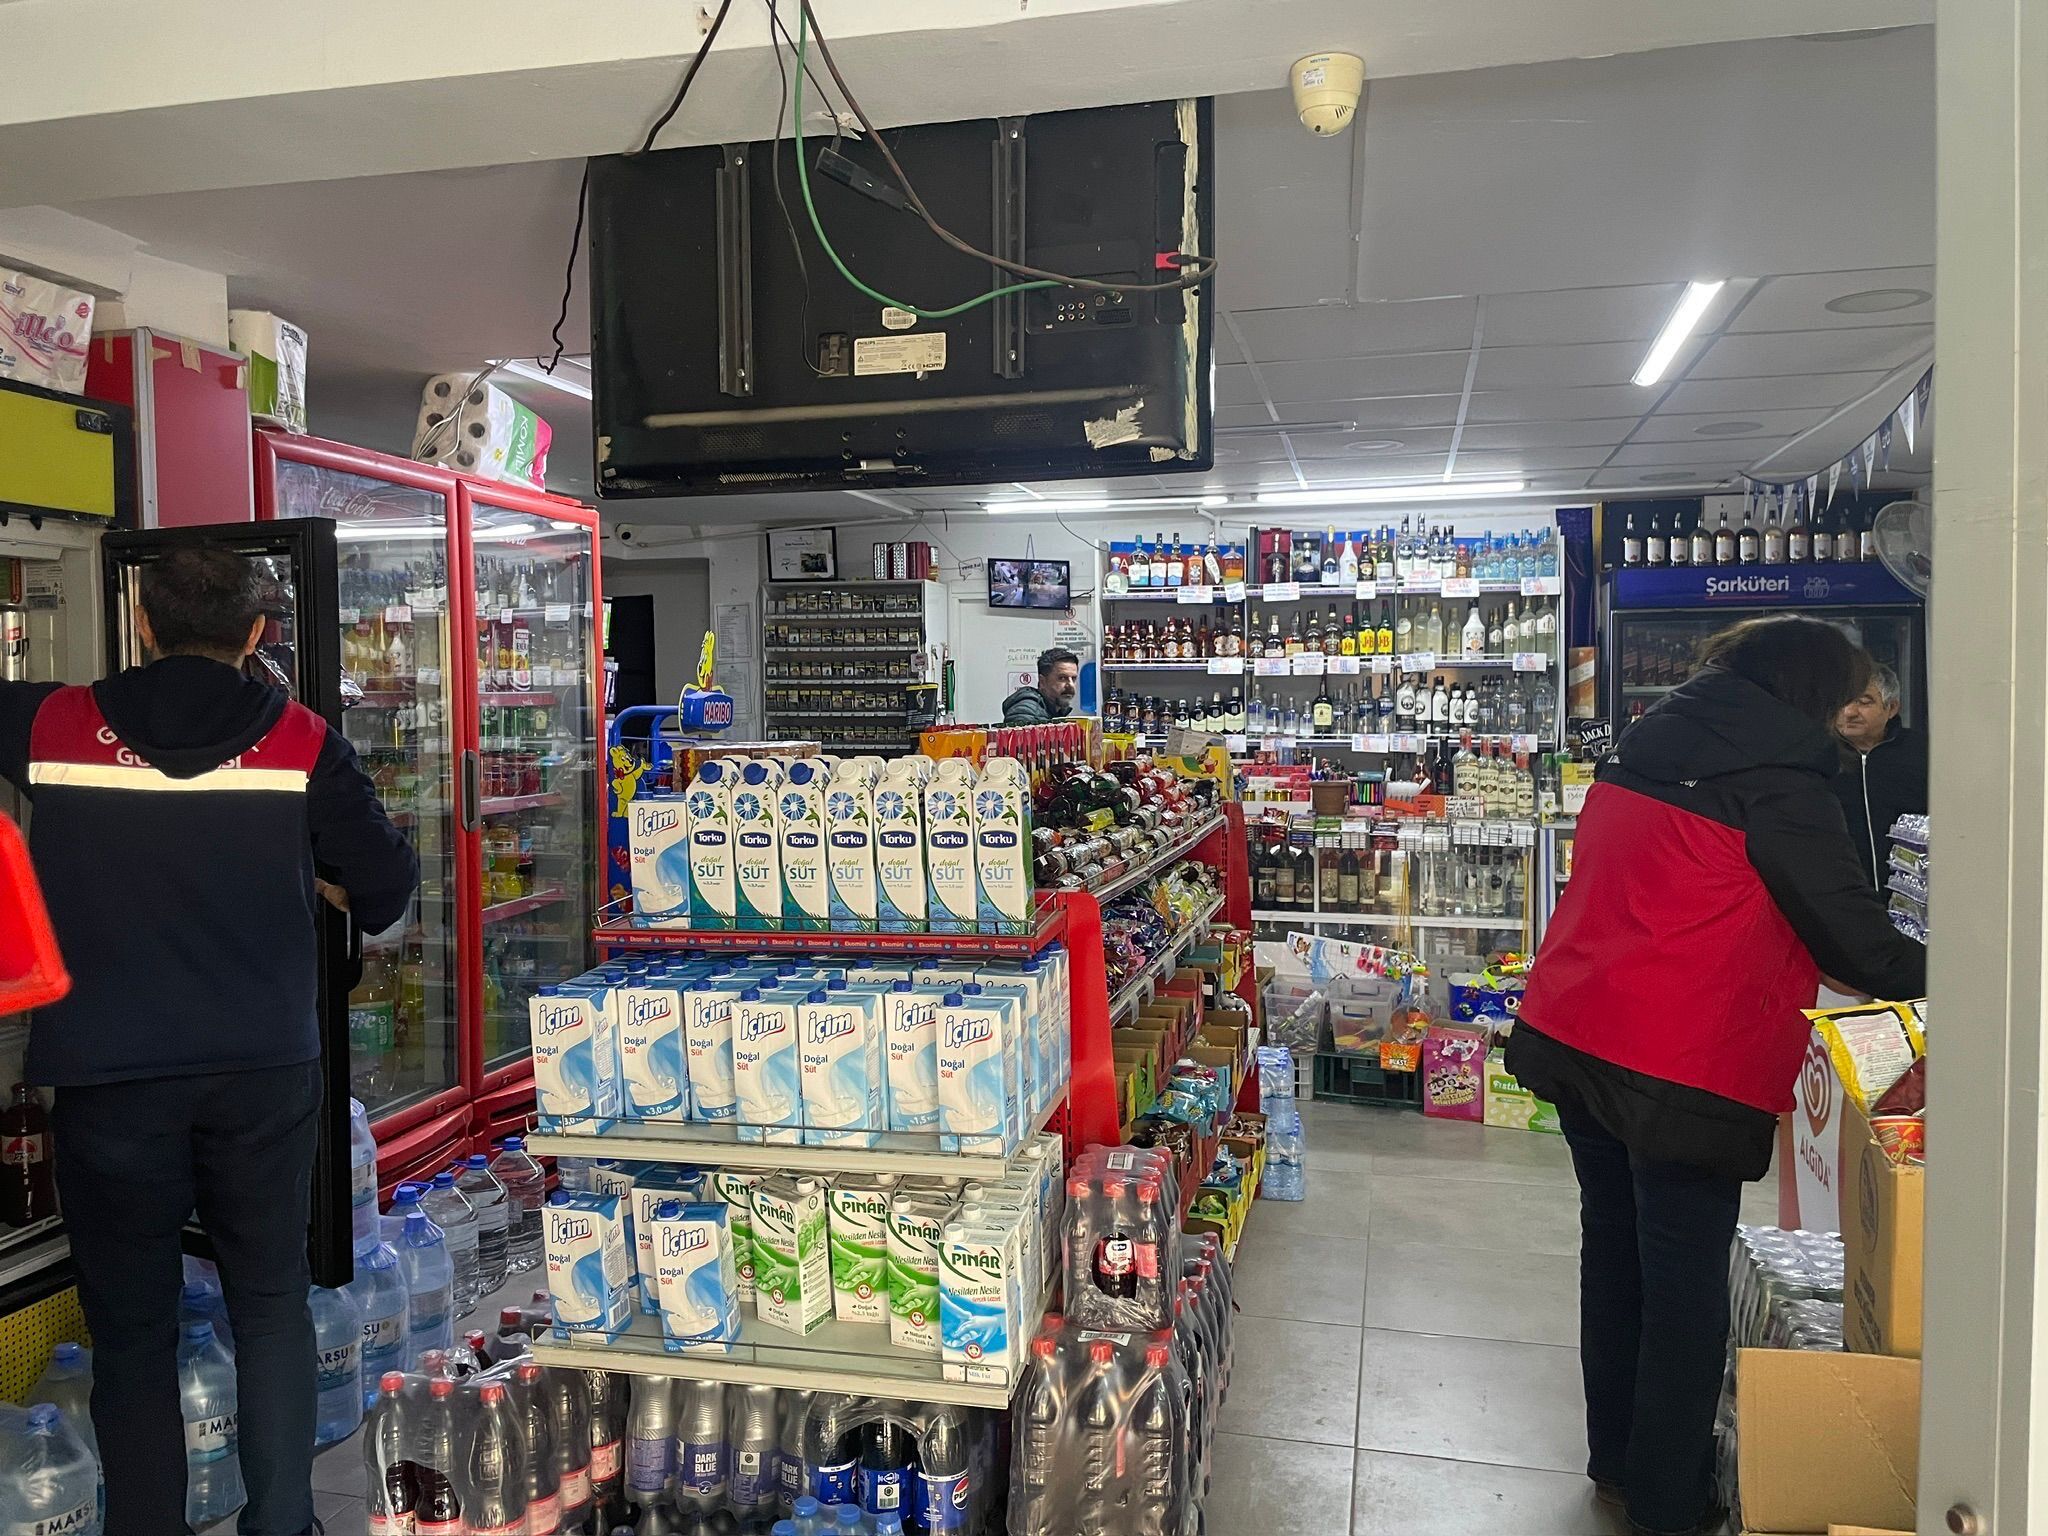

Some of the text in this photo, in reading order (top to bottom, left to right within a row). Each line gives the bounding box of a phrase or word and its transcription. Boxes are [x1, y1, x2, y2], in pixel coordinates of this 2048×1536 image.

[1706, 575, 1790, 597] Şarküteri
[704, 701, 731, 725] HARIBO
[1581, 725, 1604, 744] JACK
[637, 808, 676, 837] İçim
[697, 833, 723, 843] Torku
[743, 836, 769, 845] Torku
[789, 836, 815, 845] Torku
[835, 834, 863, 845] Torku
[883, 834, 912, 844] Torku
[935, 834, 964, 845] Torku
[983, 834, 1013, 844] Torku
[634, 847, 655, 857] Doğal
[698, 864, 725, 877] SÜT
[743, 866, 770, 880] SÜT
[790, 866, 817, 880] SÜT
[836, 866, 864, 880] SÜT
[884, 866, 913, 880] SÜT
[936, 867, 965, 881] SÜT
[985, 867, 1014, 881] SÜT
[627, 995, 669, 1026] İçim
[895, 1000, 937, 1031] İçim
[538, 1004, 580, 1035] İçim
[740, 1009, 783, 1041] İçim
[808, 1011, 853, 1043] İçim
[945, 1015, 990, 1048] İçim
[624, 1037, 647, 1045] Doğal
[690, 1039, 713, 1048] Doğal
[536, 1046, 559, 1055] Doğal
[624, 1046, 637, 1054] Süt
[691, 1048, 703, 1056] Süt
[890, 1043, 915, 1053] Doğal
[536, 1056, 549, 1064] Süt
[736, 1052, 760, 1062] Doğal
[804, 1055, 828, 1065] Doğal
[891, 1053, 903, 1061] Süt
[737, 1062, 749, 1071] Süt
[804, 1065, 817, 1073] Süt
[940, 1059, 965, 1071] Doğal
[941, 1070, 954, 1078] Süt
[760, 1205, 794, 1223] PINAR
[552, 1214, 589, 1244] İçim
[898, 1222, 941, 1241] PINAR
[663, 1227, 706, 1257] İçim
[549, 1254, 570, 1265] Doğal
[952, 1250, 1001, 1269] PINAR
[549, 1264, 561, 1272] Süt
[659, 1267, 684, 1279] Doğal
[660, 1277, 673, 1285] Süt
[948, 1285, 1000, 1297] Nesilden Nesile
[695, 1452, 717, 1463] DARK
[695, 1462, 717, 1473] BLUE
[781, 1461, 799, 1474] DARK
[781, 1472, 799, 1486] BLUE
